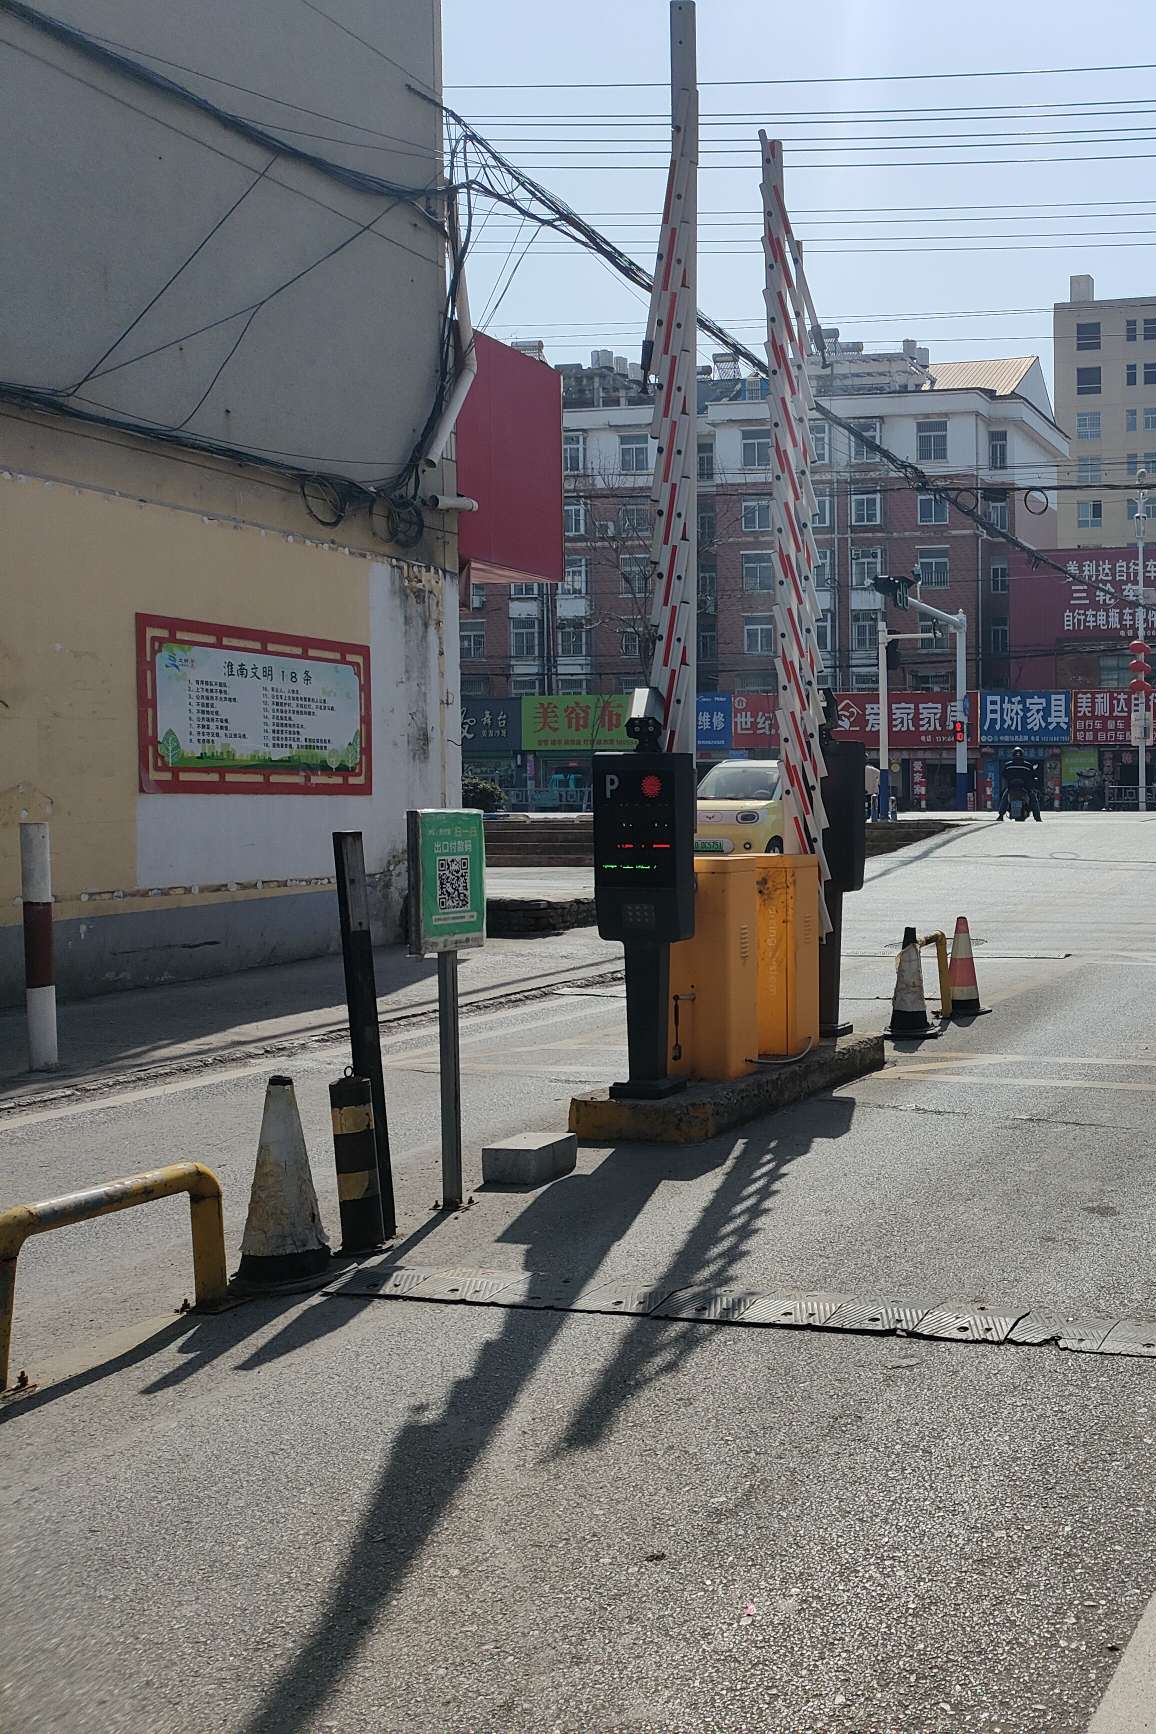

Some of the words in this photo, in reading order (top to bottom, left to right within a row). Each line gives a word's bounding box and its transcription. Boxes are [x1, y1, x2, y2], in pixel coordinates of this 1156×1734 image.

[984, 694, 1069, 731] 月娇家具
[605, 775, 620, 799] P
